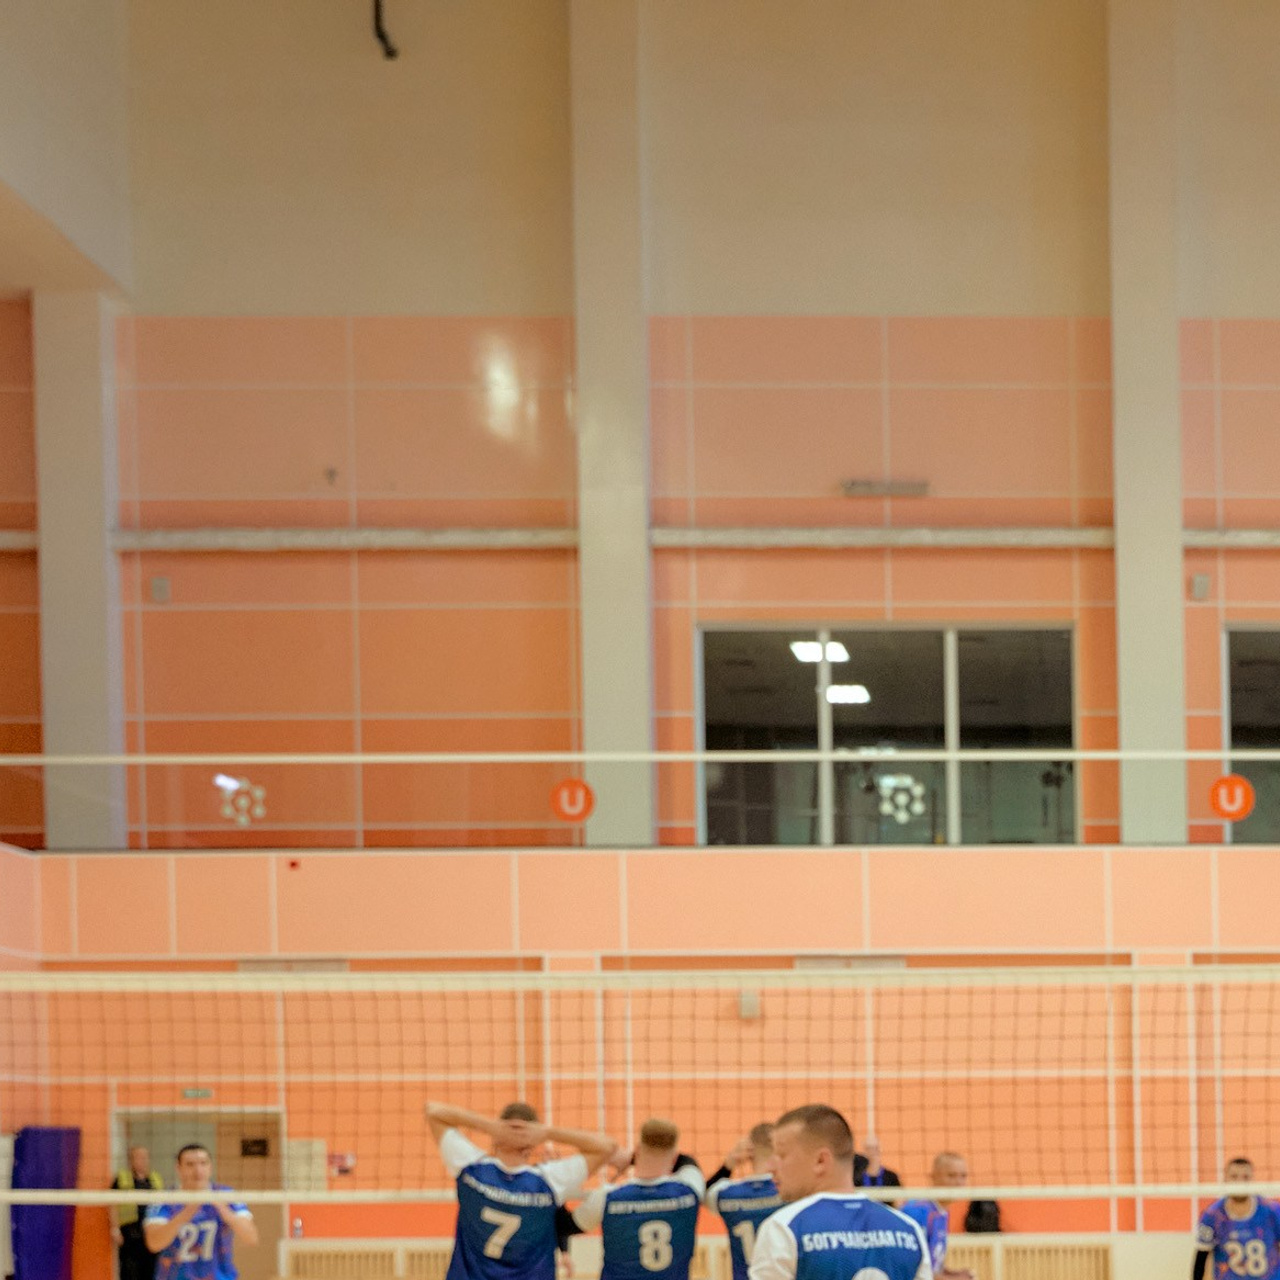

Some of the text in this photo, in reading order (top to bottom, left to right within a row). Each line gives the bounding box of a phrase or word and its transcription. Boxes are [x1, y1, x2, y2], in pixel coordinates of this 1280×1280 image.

[560, 786, 585, 816] U
[1219, 785, 1243, 812] U
[178, 1220, 218, 1262] 27
[480, 1205, 522, 1259] 7
[638, 1219, 673, 1272] 8
[1223, 1239, 1268, 1277] 28
